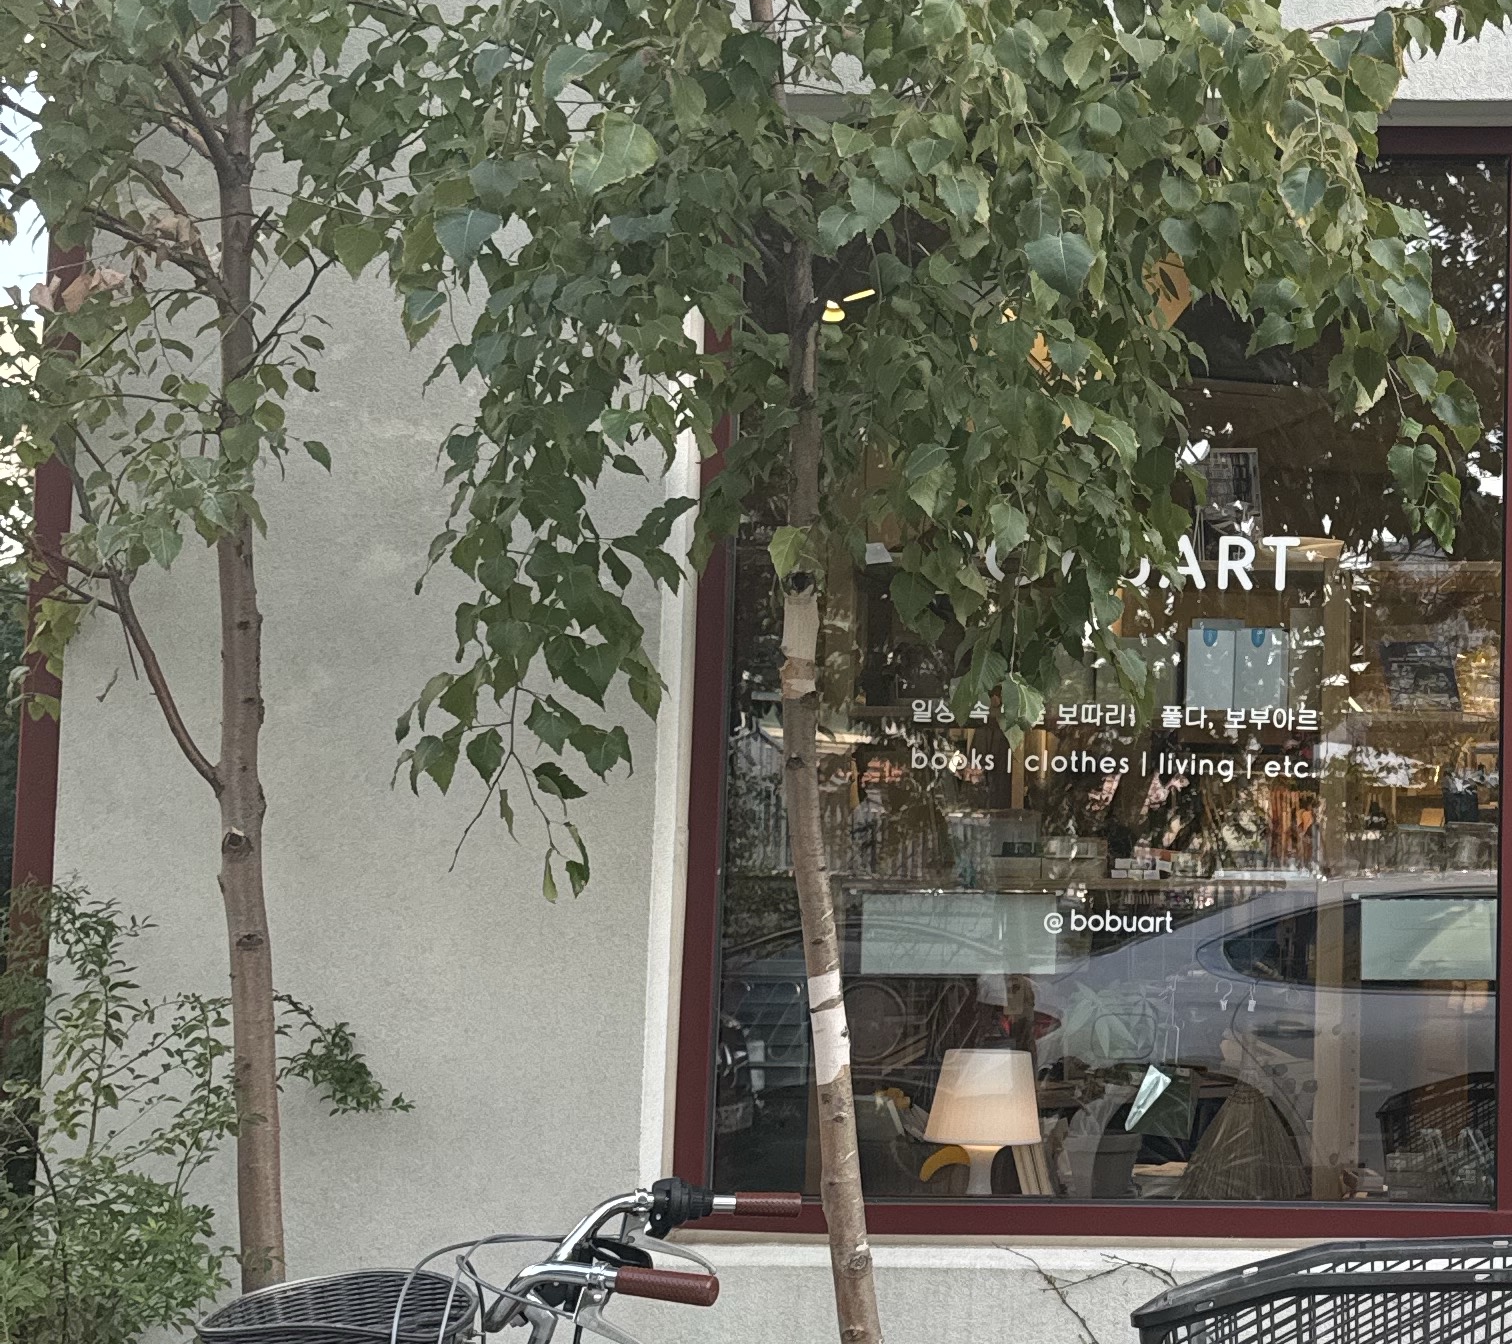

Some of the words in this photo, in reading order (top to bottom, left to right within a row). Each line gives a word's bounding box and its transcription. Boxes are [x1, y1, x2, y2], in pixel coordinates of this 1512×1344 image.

[969, 700, 990, 724] 속
[1056, 703, 1136, 727] 보따리
[1160, 705, 1215, 730] 풀다,
[1224, 706, 1319, 731] 보부아르
[911, 747, 995, 773] books
[1024, 749, 1130, 774] clothes
[1159, 751, 1235, 783] living
[1264, 755, 1317, 779] etc.
[1070, 908, 1173, 934] bobuart
